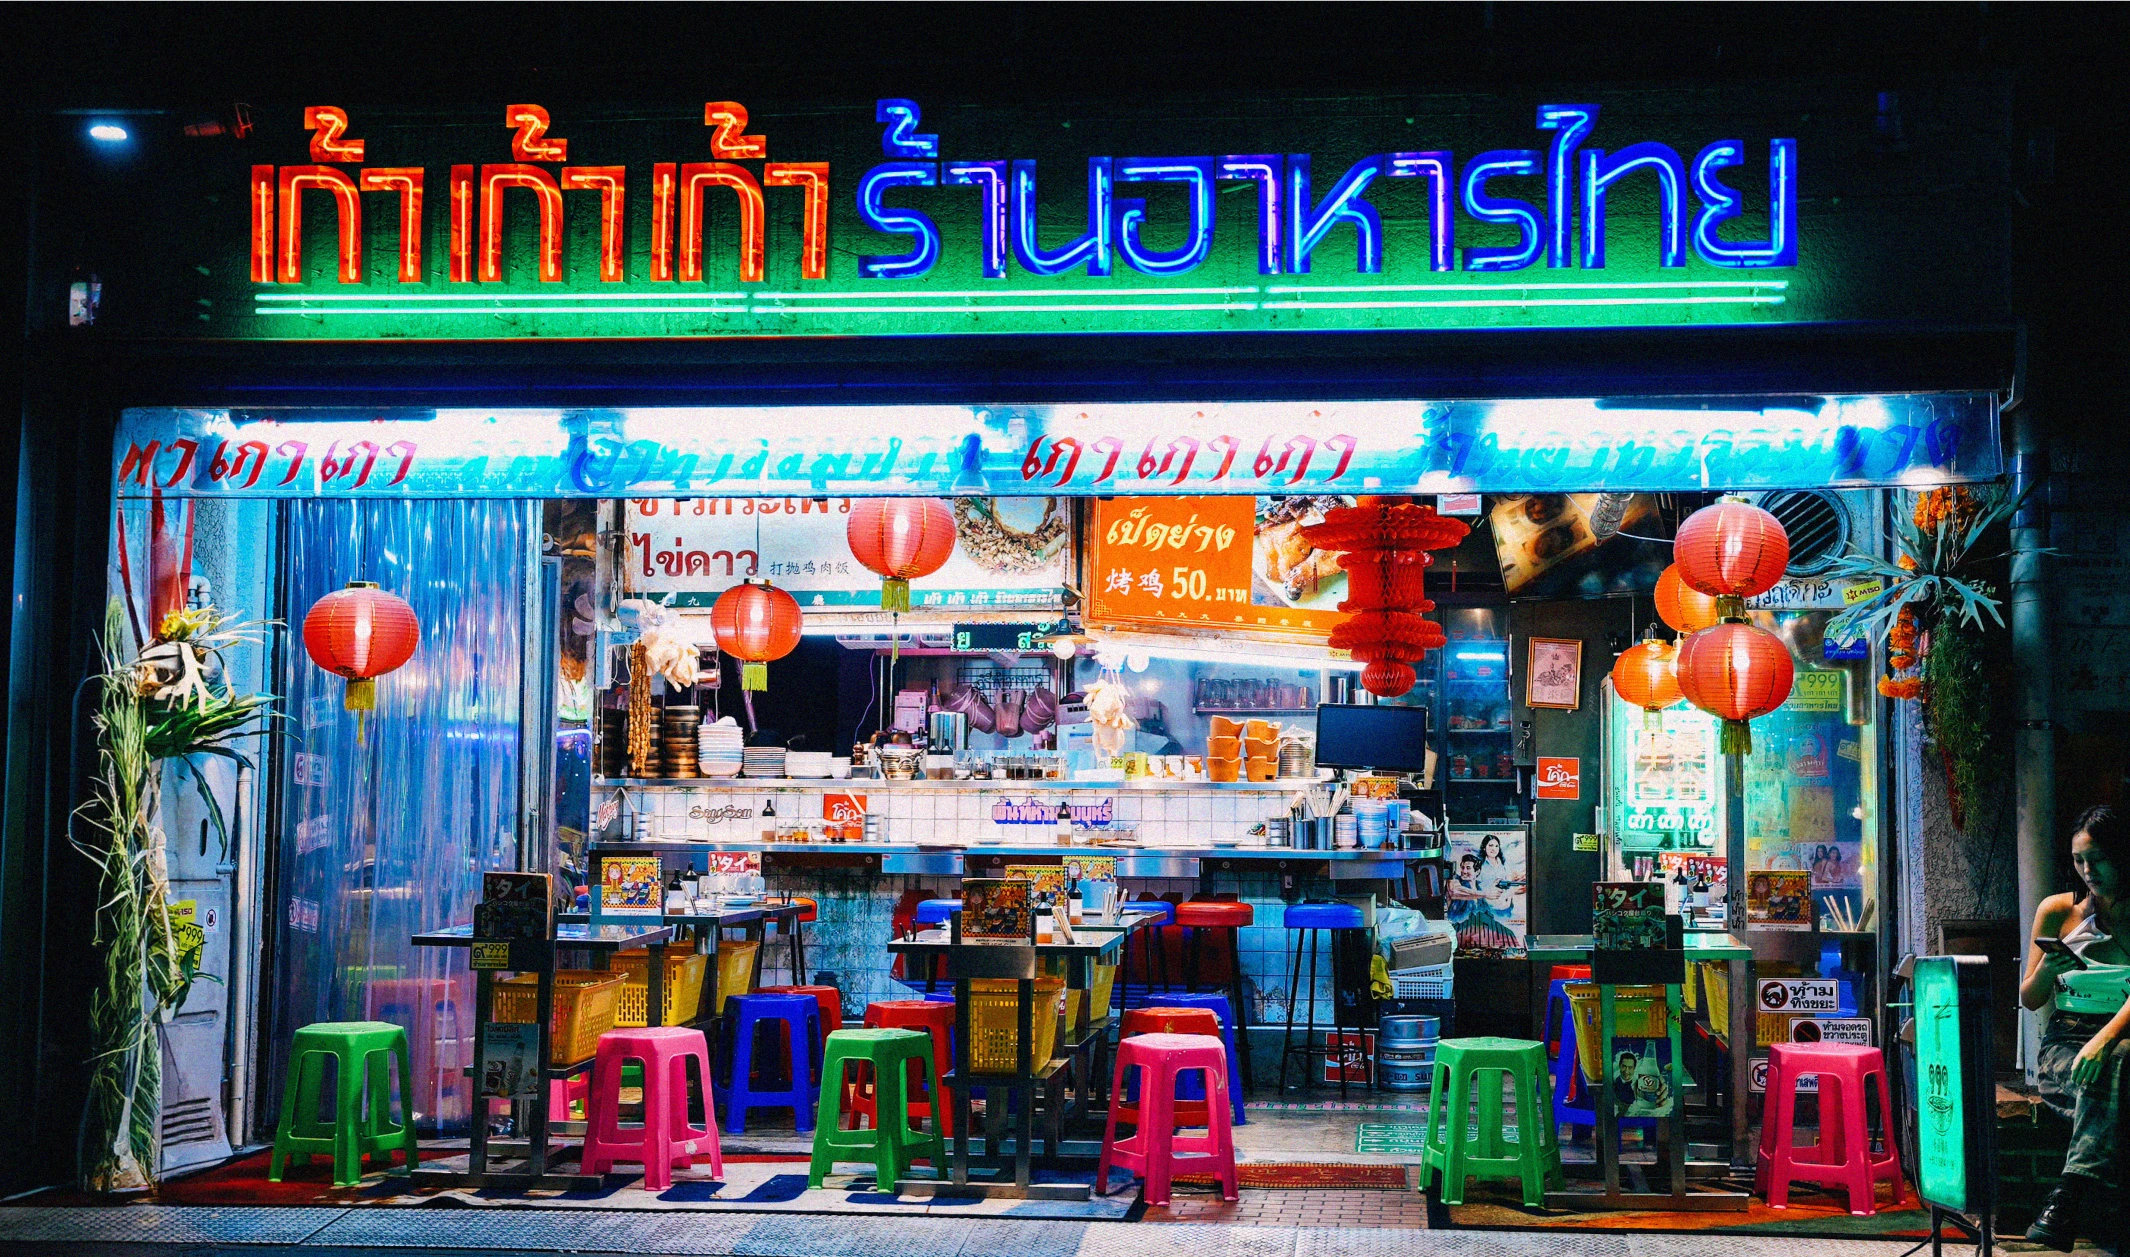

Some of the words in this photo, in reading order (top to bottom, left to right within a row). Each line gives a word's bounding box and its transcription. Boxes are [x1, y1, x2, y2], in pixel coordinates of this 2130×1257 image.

[250, 106, 424, 283] เก้า
[450, 104, 625, 283] เก้า
[651, 101, 829, 282] เก้า
[857, 98, 1798, 279] ร้านอาหารไทย
[1106, 506, 1236, 553] เป็ดย่าง
[632, 532, 759, 577] ไข่ดาว
[1105, 568, 1164, 598] 烤鸡
[1609, 887, 1648, 909] タイ
[488, 943, 508, 954] 999
[1789, 981, 1834, 996] ห้าม
[1789, 996, 1836, 1009] ทิ้งขยะ
[1822, 1020, 1868, 1032] ห้ามจอดรถ
[1822, 1032, 1868, 1042] ขวางประตู
